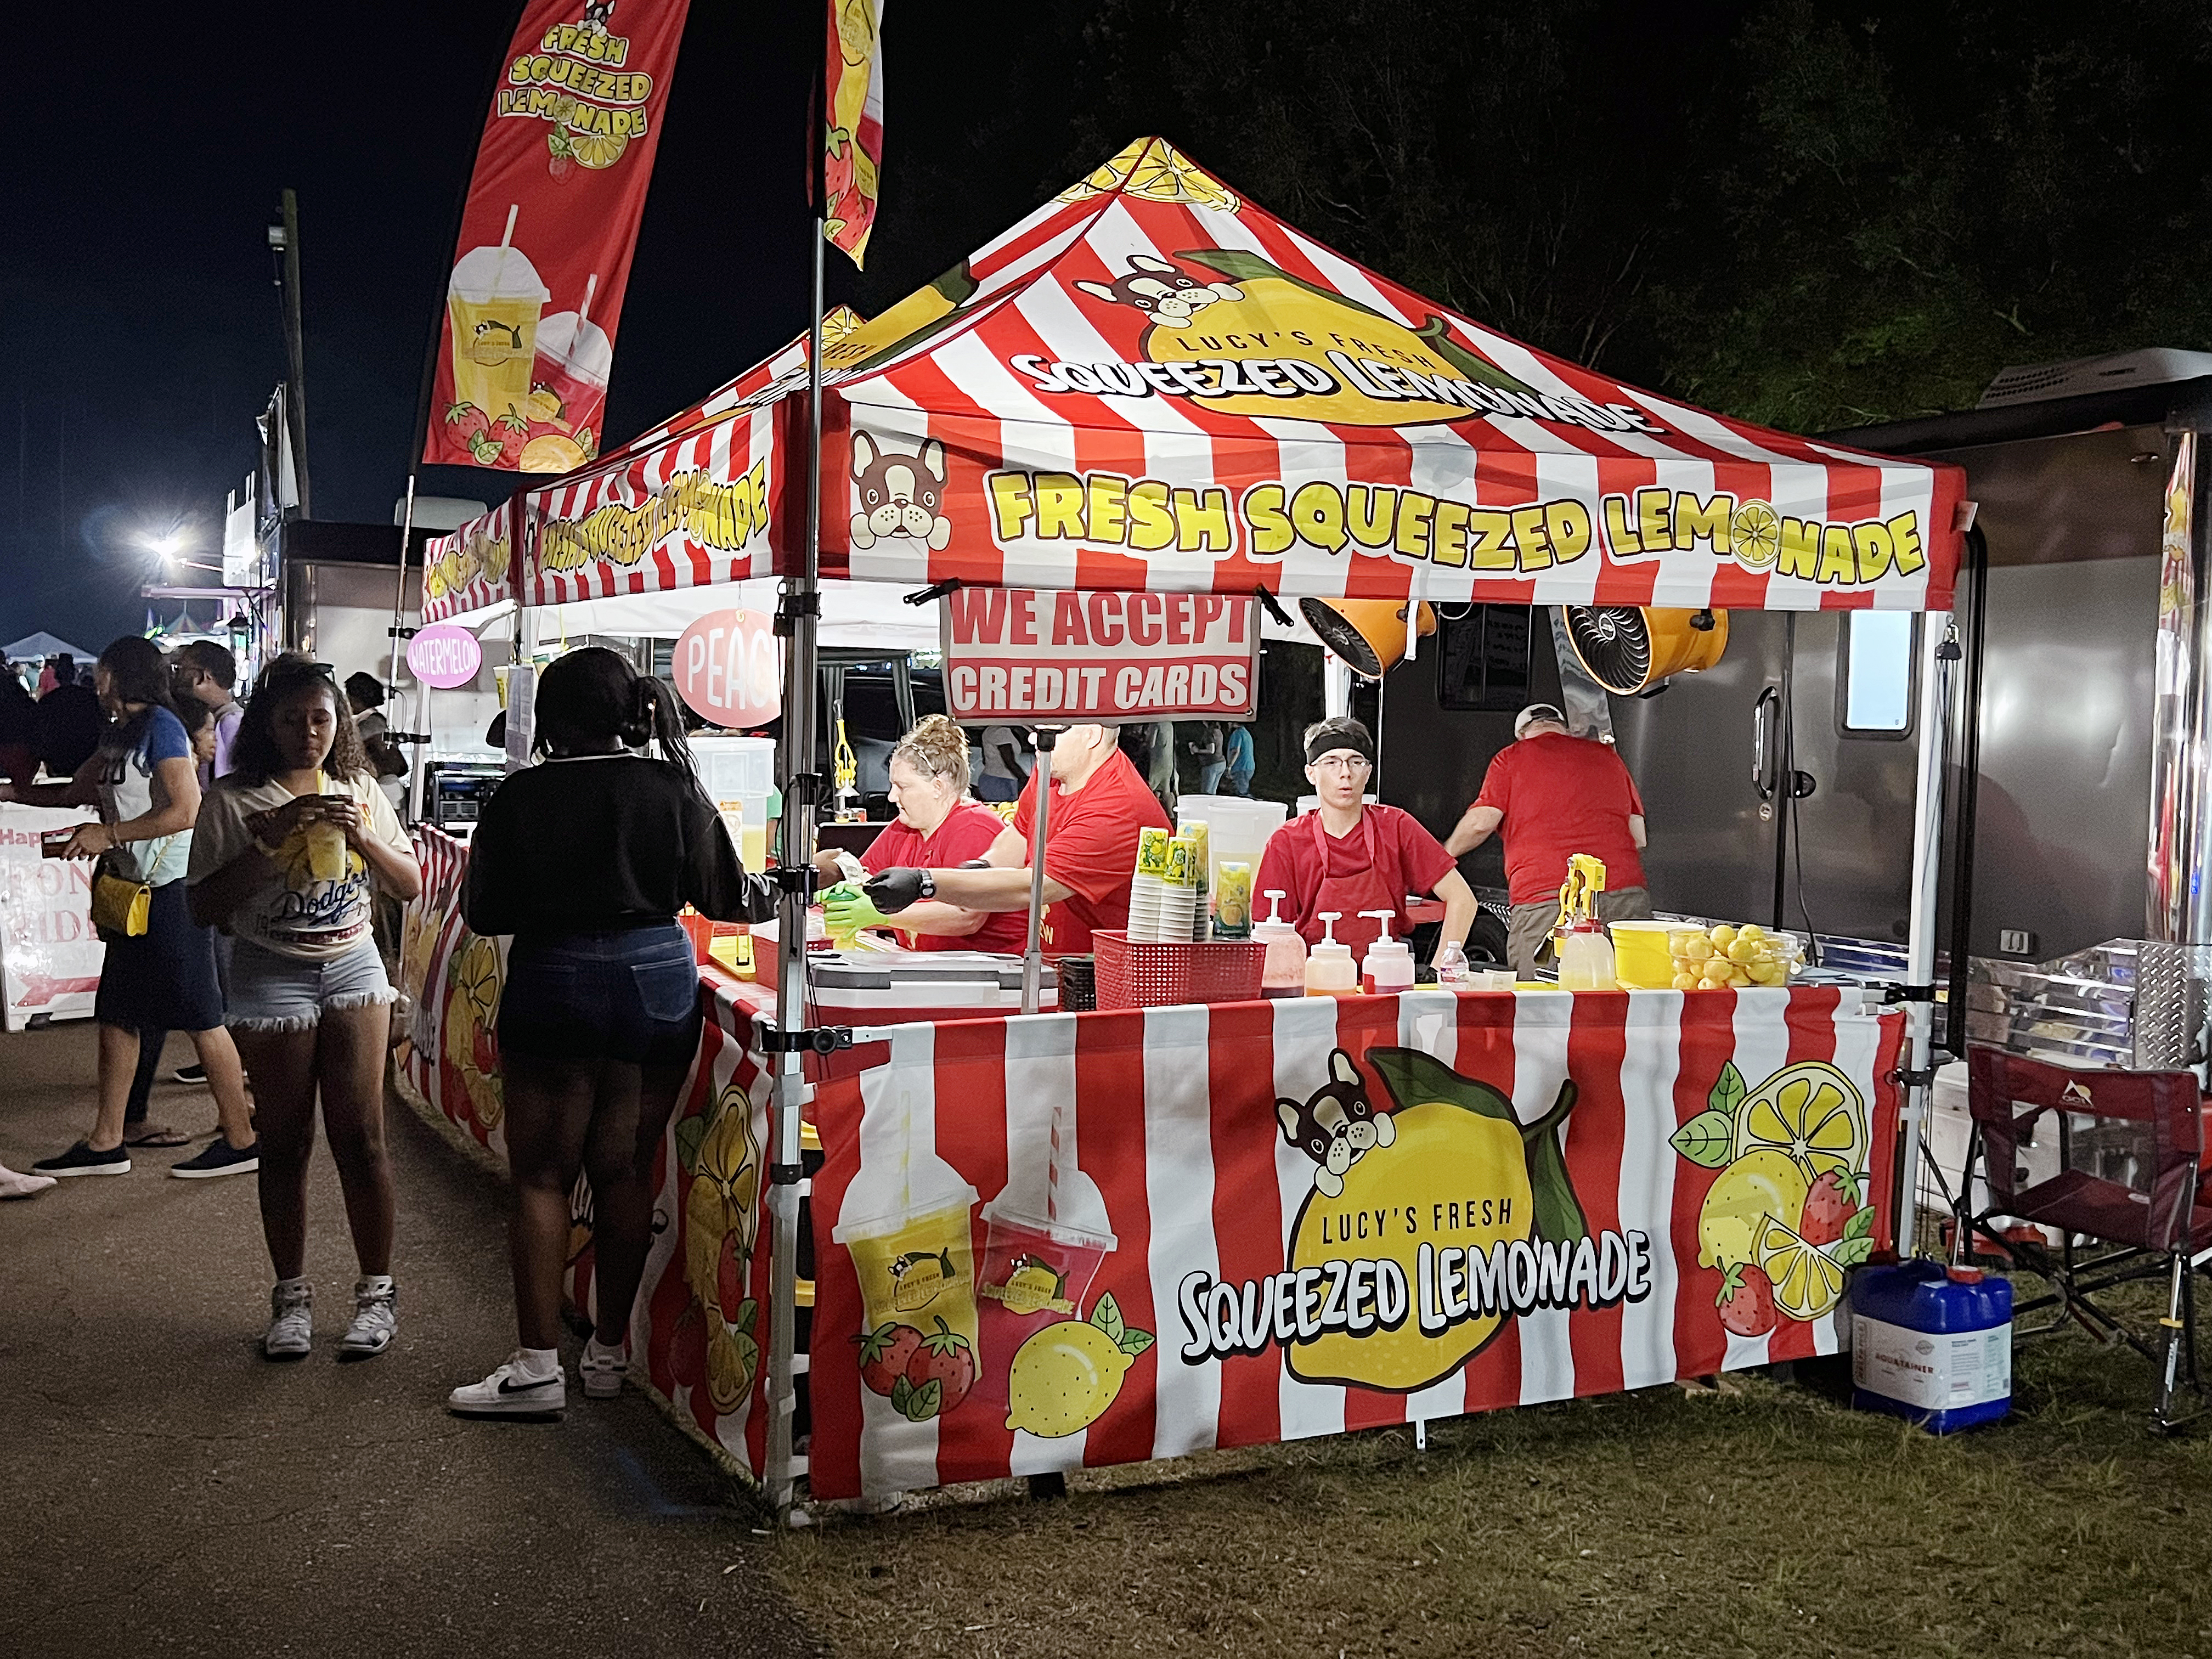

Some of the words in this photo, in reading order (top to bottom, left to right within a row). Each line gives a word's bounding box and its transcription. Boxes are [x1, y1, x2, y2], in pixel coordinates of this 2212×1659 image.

[542, 25, 627, 64] FRESH
[511, 55, 651, 101] SQUEEZED
[500, 89, 646, 135] LEMONADE
[1177, 330, 1312, 353] LUCY'S
[1335, 331, 1438, 370] FRESH
[1011, 354, 1342, 399] SQUEEZED
[1330, 350, 1668, 434] LEMONADE
[989, 471, 1232, 552] FRESH
[1245, 482, 1593, 572] SQUEEZED
[1604, 488, 1926, 584] LEMONADE
[951, 589, 1039, 645] WE
[1051, 592, 1252, 646] ACCEPT
[411, 637, 477, 675] WATERMELON
[951, 665, 1106, 712] CREDIT
[1114, 663, 1249, 710] CARDS
[1323, 1206, 1418, 1245] LUCY'S
[1433, 1198, 1513, 1231] FRESH
[1178, 1258, 1409, 1366] SQUEEZED
[1417, 1229, 1651, 1336] LEMONADE
